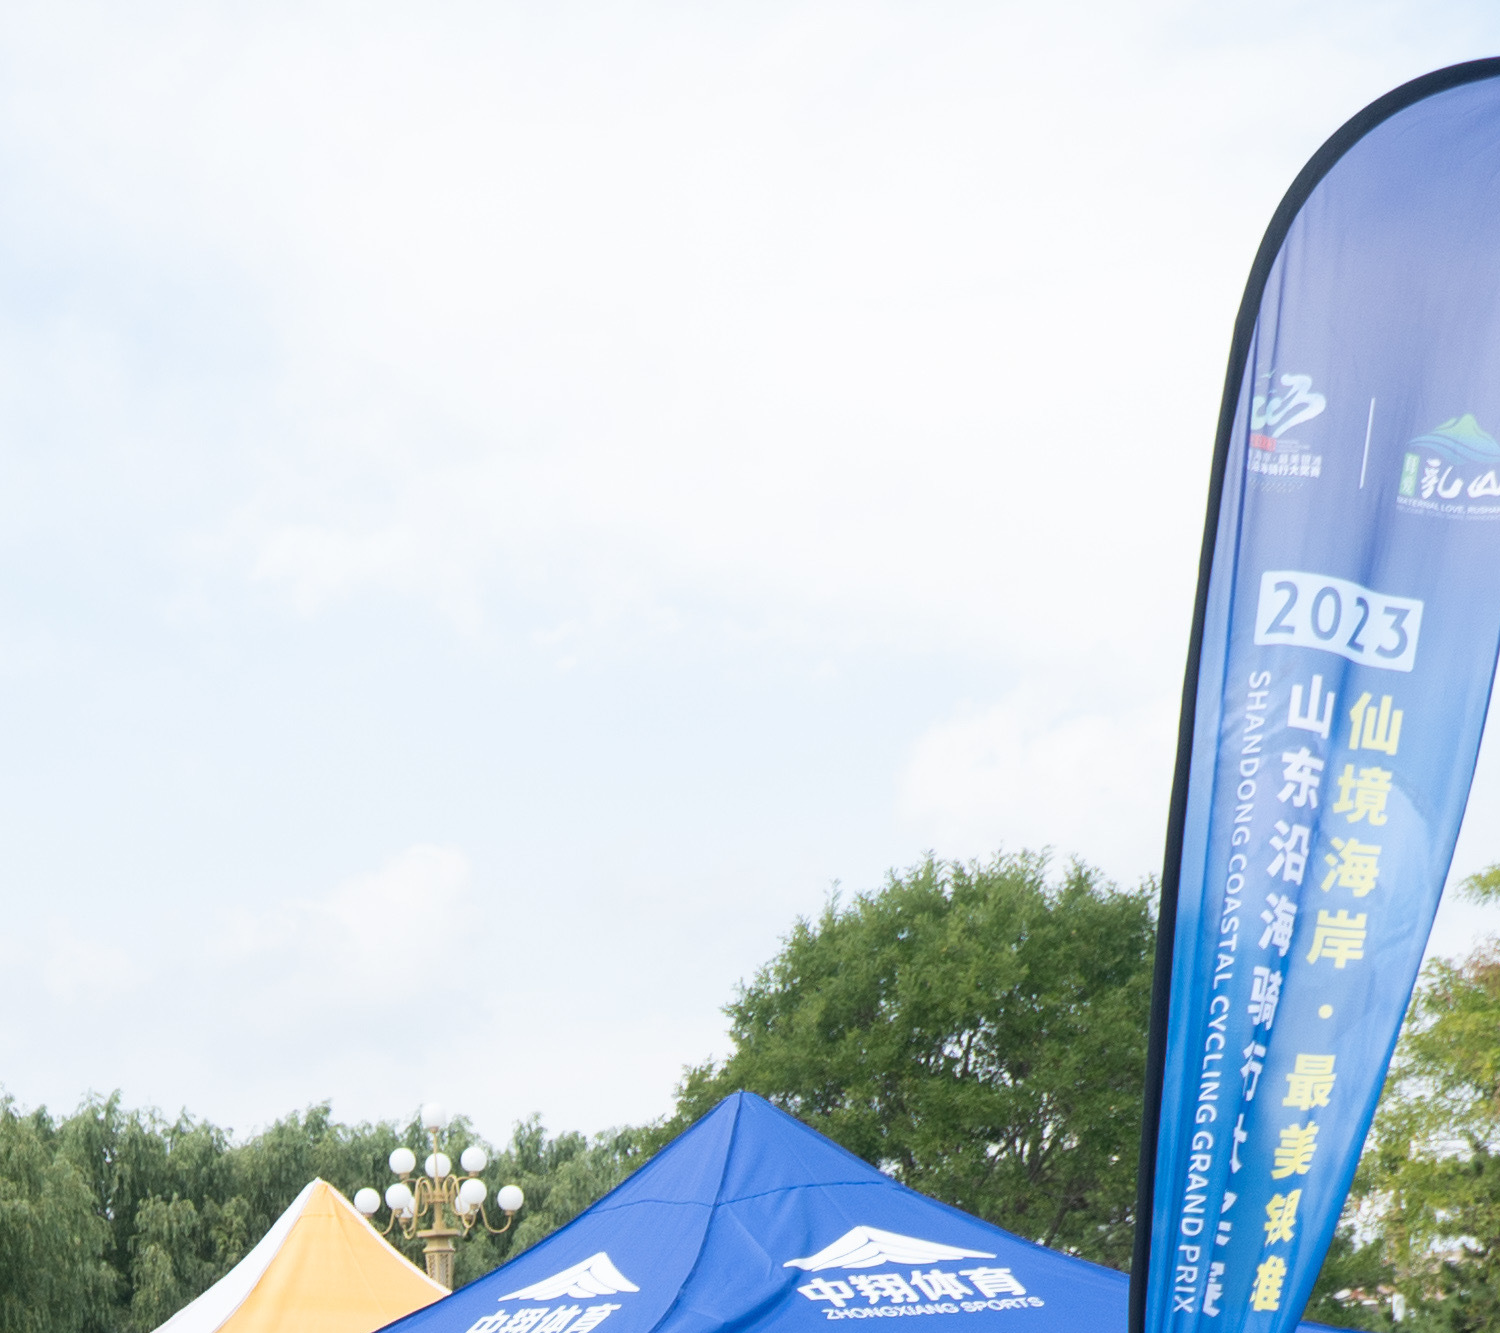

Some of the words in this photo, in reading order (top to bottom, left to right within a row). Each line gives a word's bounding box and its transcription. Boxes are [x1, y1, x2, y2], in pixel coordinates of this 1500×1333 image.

[1264, 580, 1414, 660] 2023
[1230, 670, 1271, 847] SHANDONG
[1212, 852, 1248, 988] COASTAL
[1194, 996, 1231, 1126] CYCLING
[1180, 1131, 1214, 1238] GRAND
[797, 1266, 1028, 1307] 中翔体育
[821, 1301, 961, 1321] ZHONGXIANG
[961, 1296, 1046, 1316] SPORTS
[1173, 1244, 1202, 1314] PRIX
